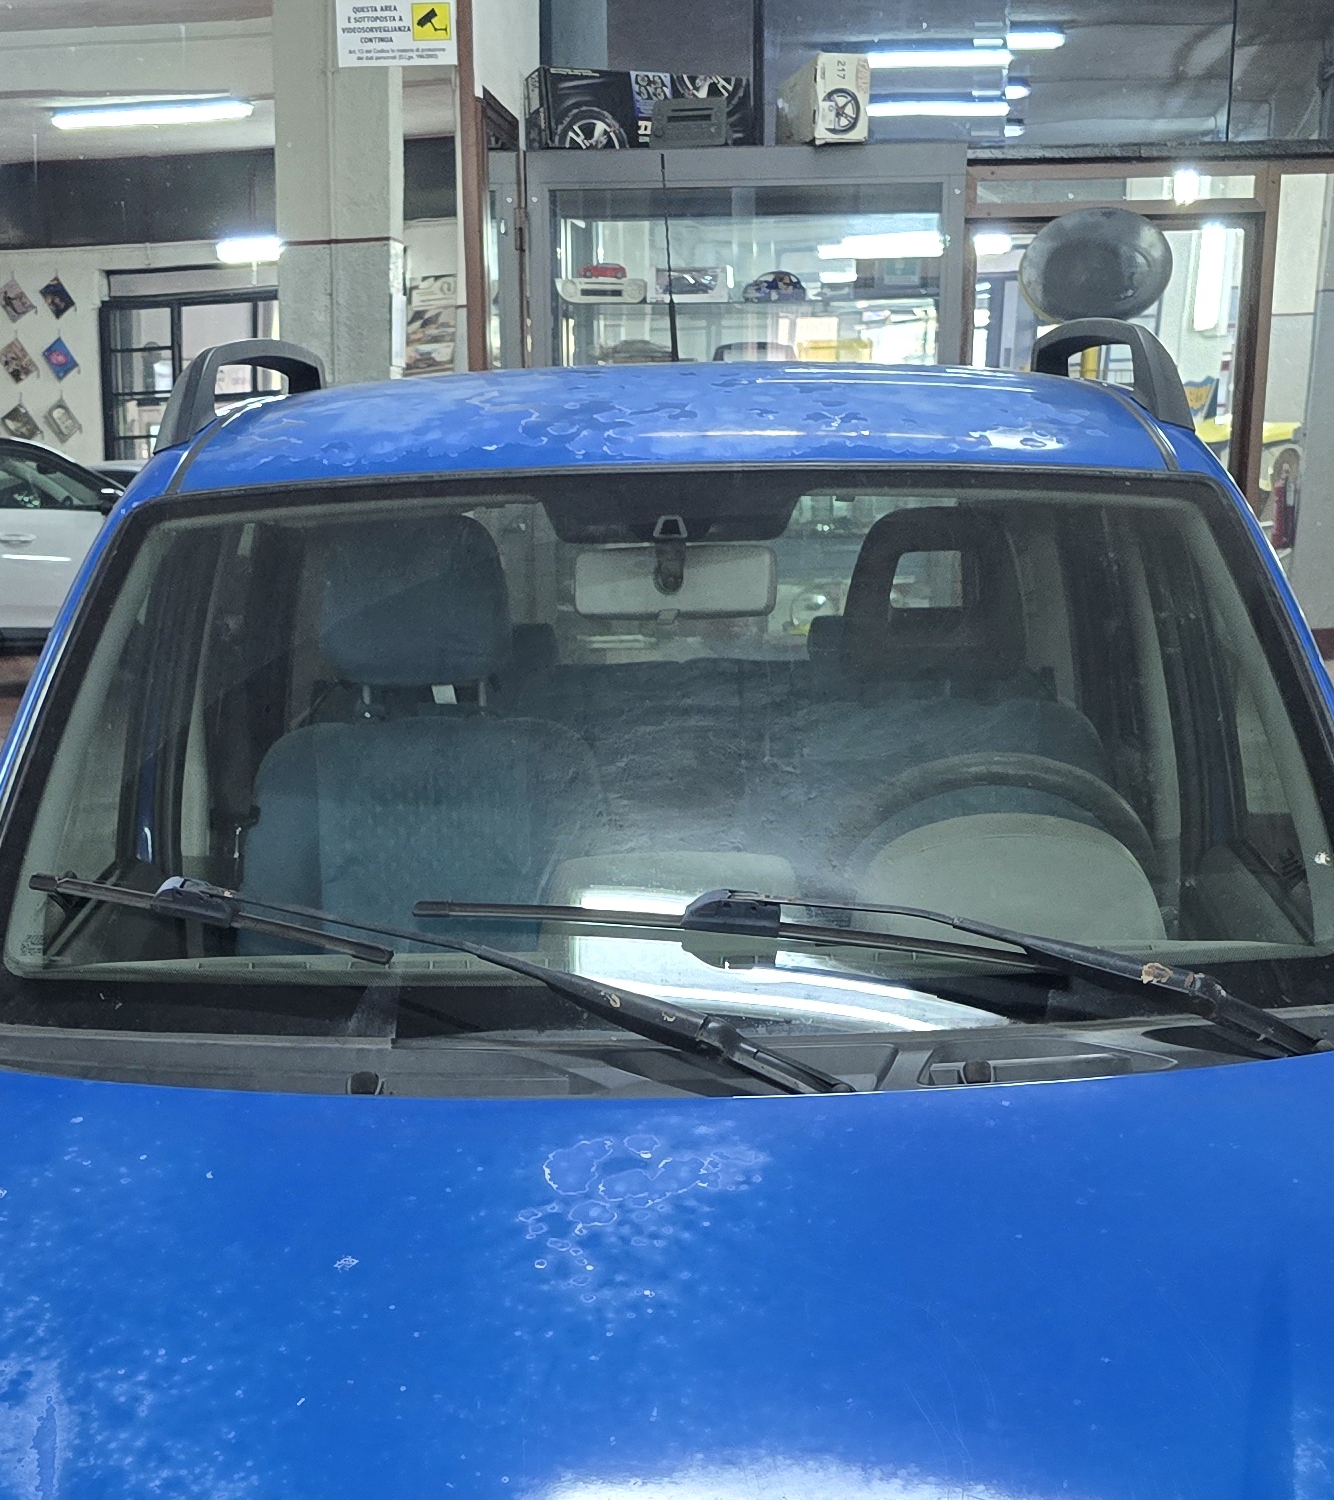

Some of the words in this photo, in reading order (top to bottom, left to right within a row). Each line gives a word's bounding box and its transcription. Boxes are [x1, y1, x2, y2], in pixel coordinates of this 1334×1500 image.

[352, 6, 378, 14] QUESTA
[354, 15, 396, 23] SOTTOPOSTA
[341, 25, 411, 34] VIDEOSORVEGLIANZA
[837, 60, 846, 80] 217
